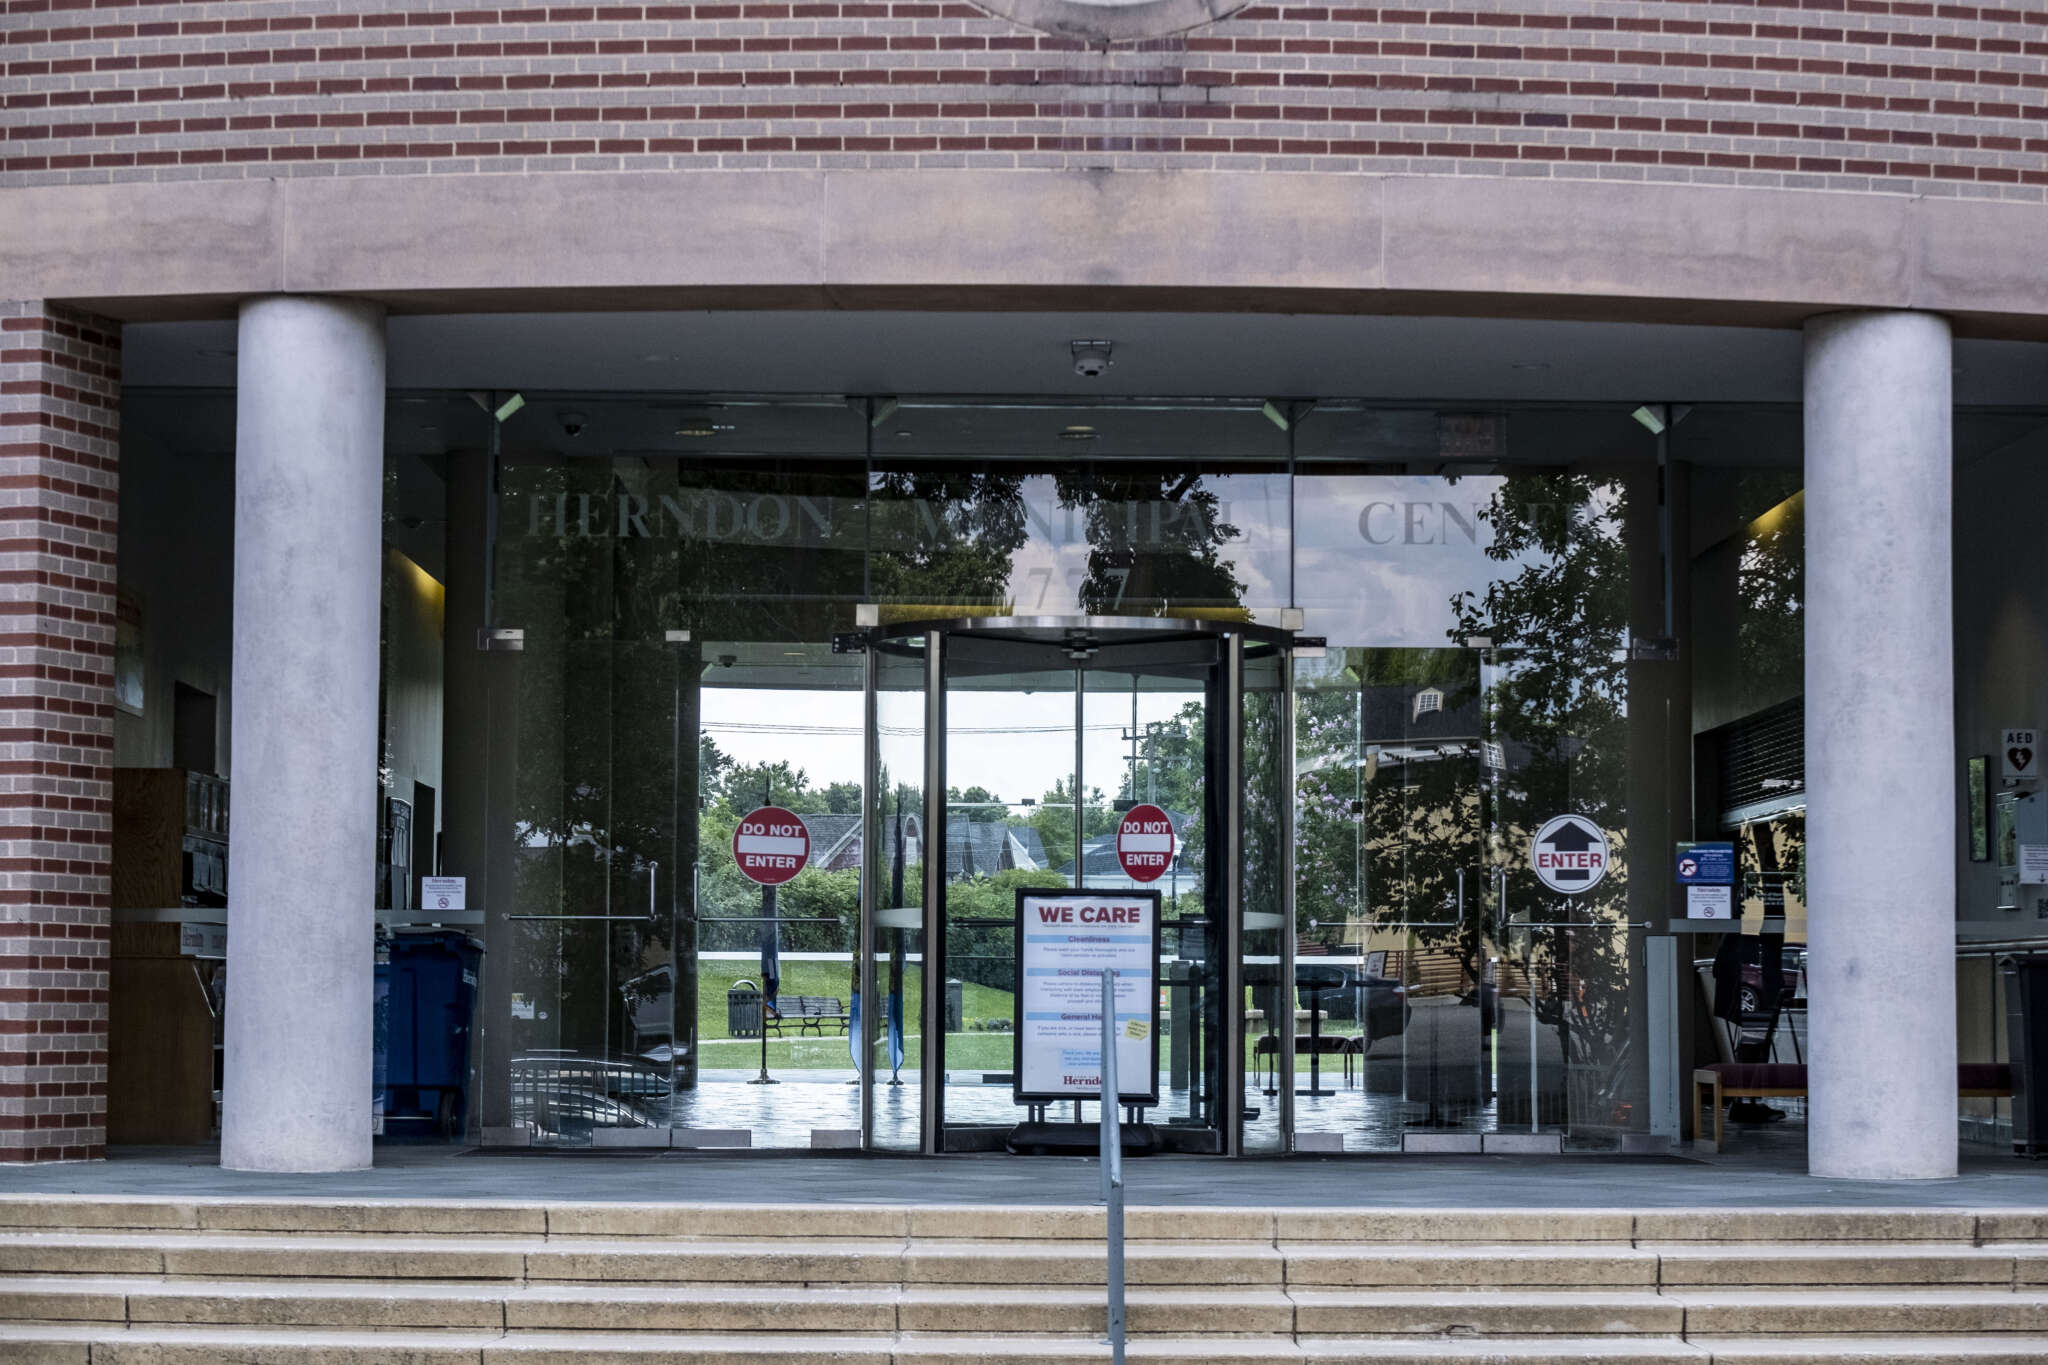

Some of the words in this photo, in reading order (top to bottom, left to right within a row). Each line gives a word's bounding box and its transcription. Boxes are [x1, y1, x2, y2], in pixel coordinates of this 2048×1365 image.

[525, 493, 834, 540] HERNDON
[913, 498, 1252, 544] MNIIPAL
[2007, 732, 2033, 744] AED
[742, 822, 765, 835] DO
[769, 824, 802, 836] NOT
[1123, 821, 1141, 834] DO
[1143, 821, 1169, 834] NOT
[745, 855, 797, 868] ENTER
[1126, 854, 1165, 866] ENTER
[1538, 853, 1603, 868] ENTER
[1038, 906, 1073, 923] WE
[1079, 906, 1141, 923] CARE
[1063, 1075, 1102, 1085] Hernd
